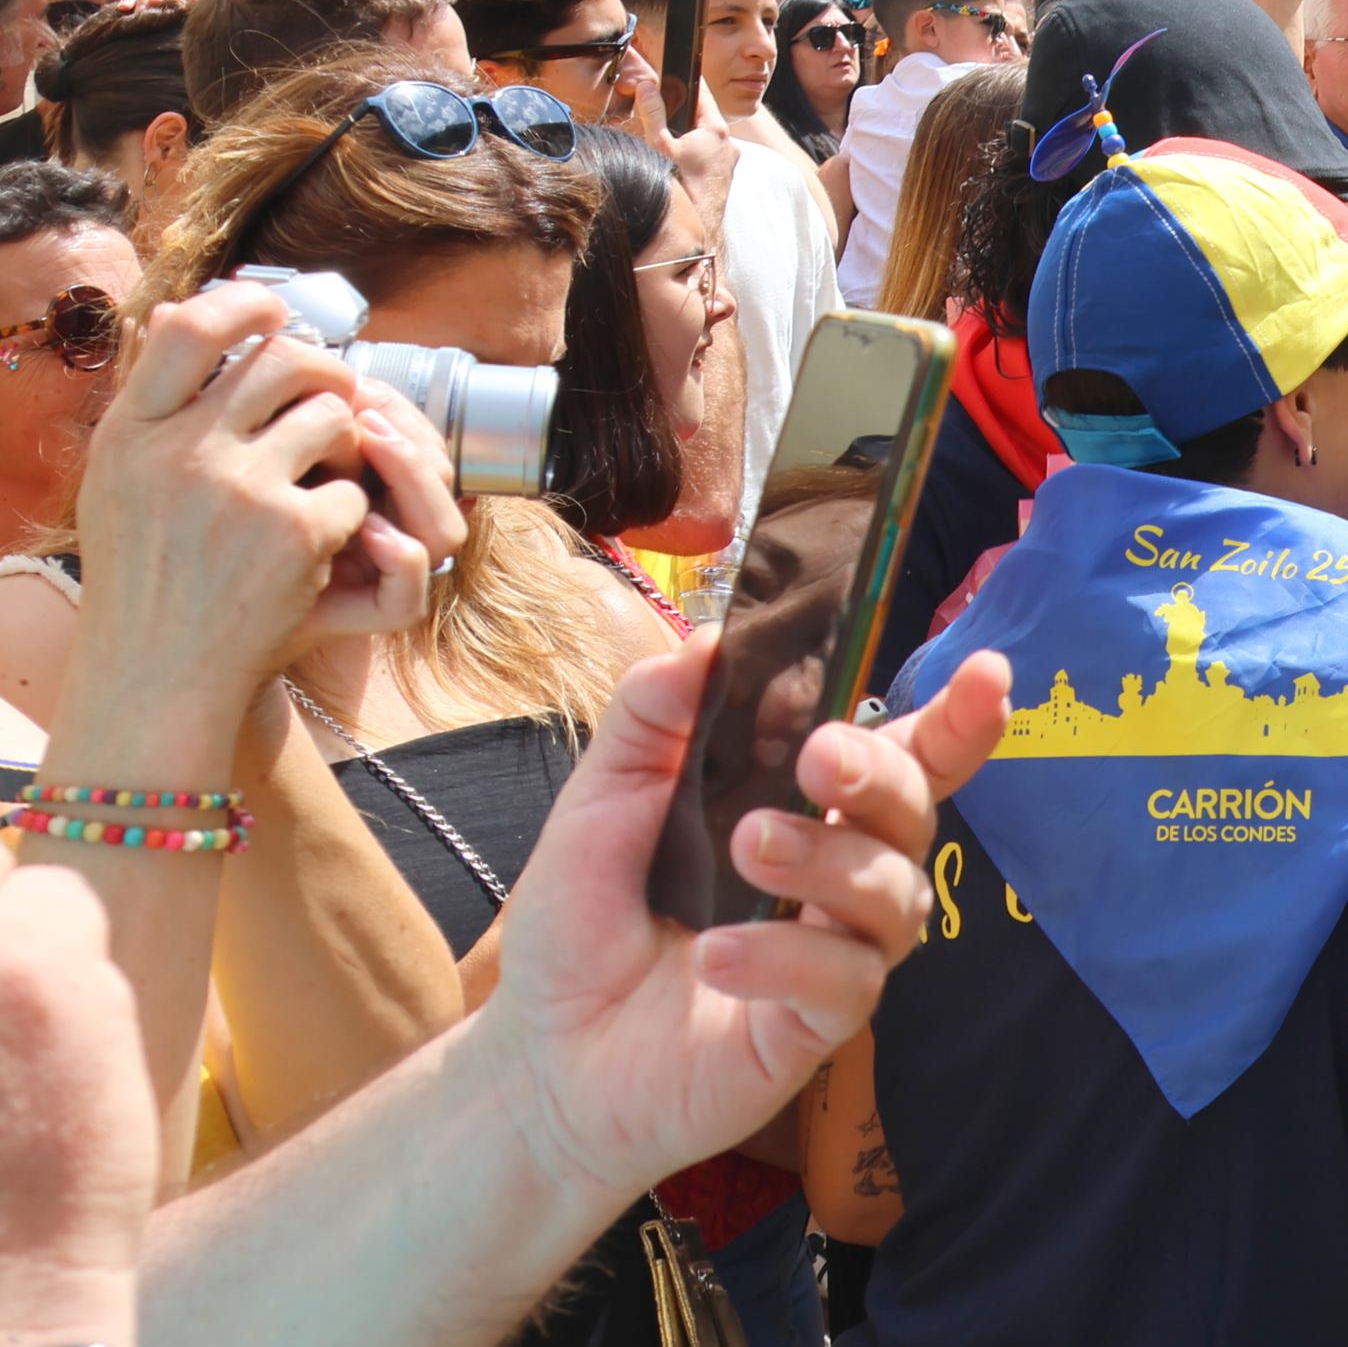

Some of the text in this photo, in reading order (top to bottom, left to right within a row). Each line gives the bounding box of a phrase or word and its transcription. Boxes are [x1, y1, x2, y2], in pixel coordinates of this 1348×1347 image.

[1124, 523, 1203, 571] San
[1208, 537, 1299, 581] Zoilo
[1147, 779, 1312, 820] CARRIÓN
[1156, 824, 1297, 843] DE LOS CONDES
